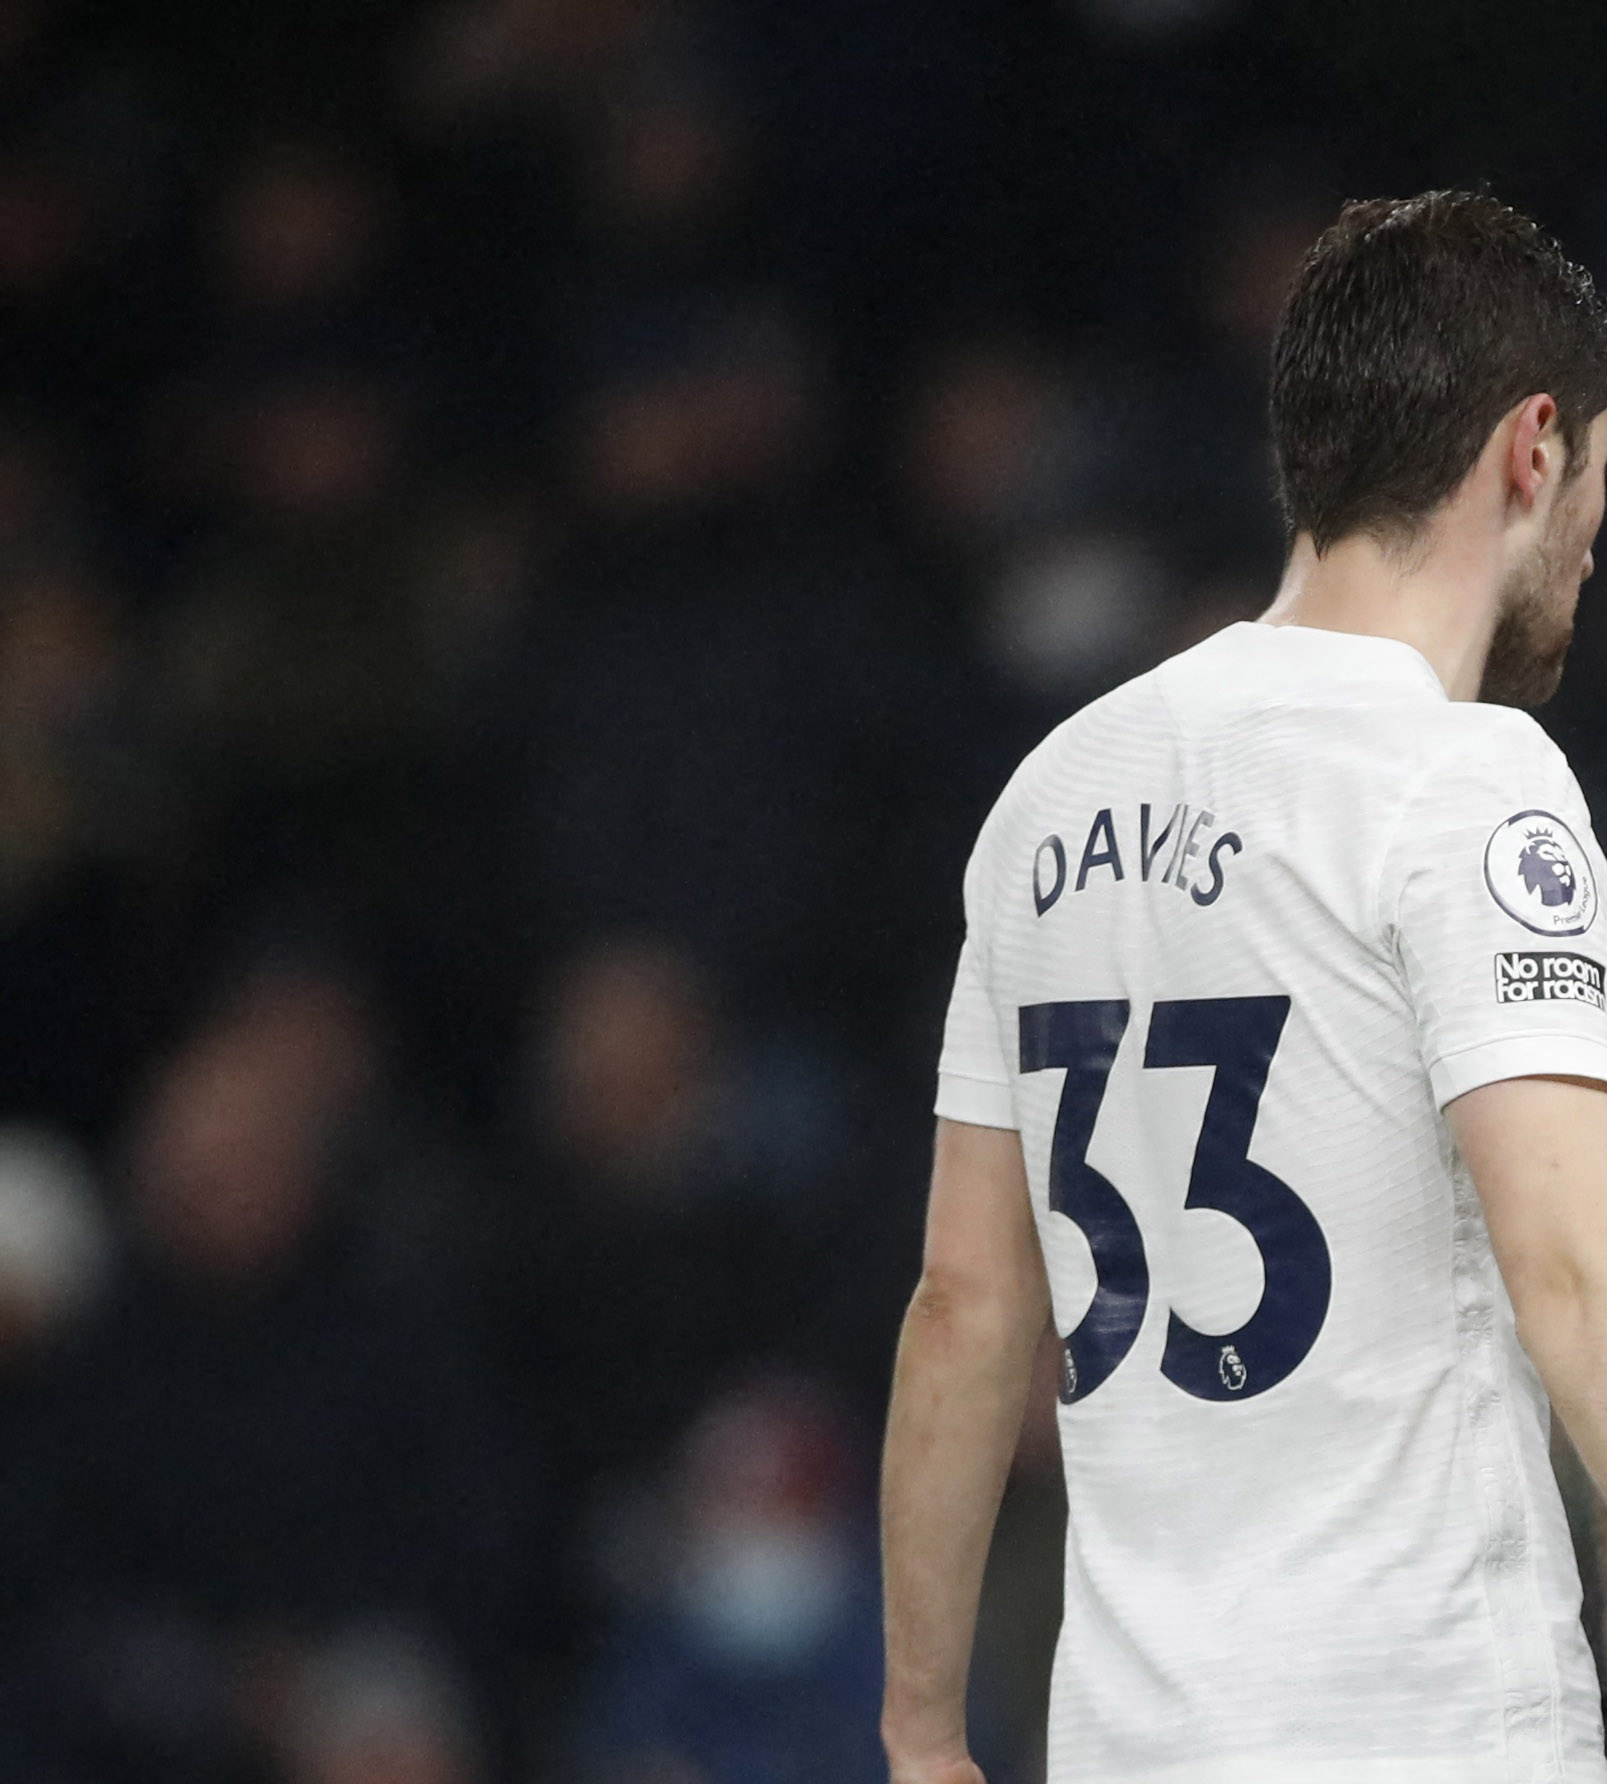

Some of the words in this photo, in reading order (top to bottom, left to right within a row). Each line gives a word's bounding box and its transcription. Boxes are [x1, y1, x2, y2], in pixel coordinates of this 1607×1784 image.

[1033, 803, 1243, 917] DAVIES
[1496, 953, 1538, 981] No
[1542, 957, 1601, 989] room
[1496, 977, 1538, 1003] for
[1543, 979, 1606, 1011] racism
[1017, 995, 1333, 1405] 33
